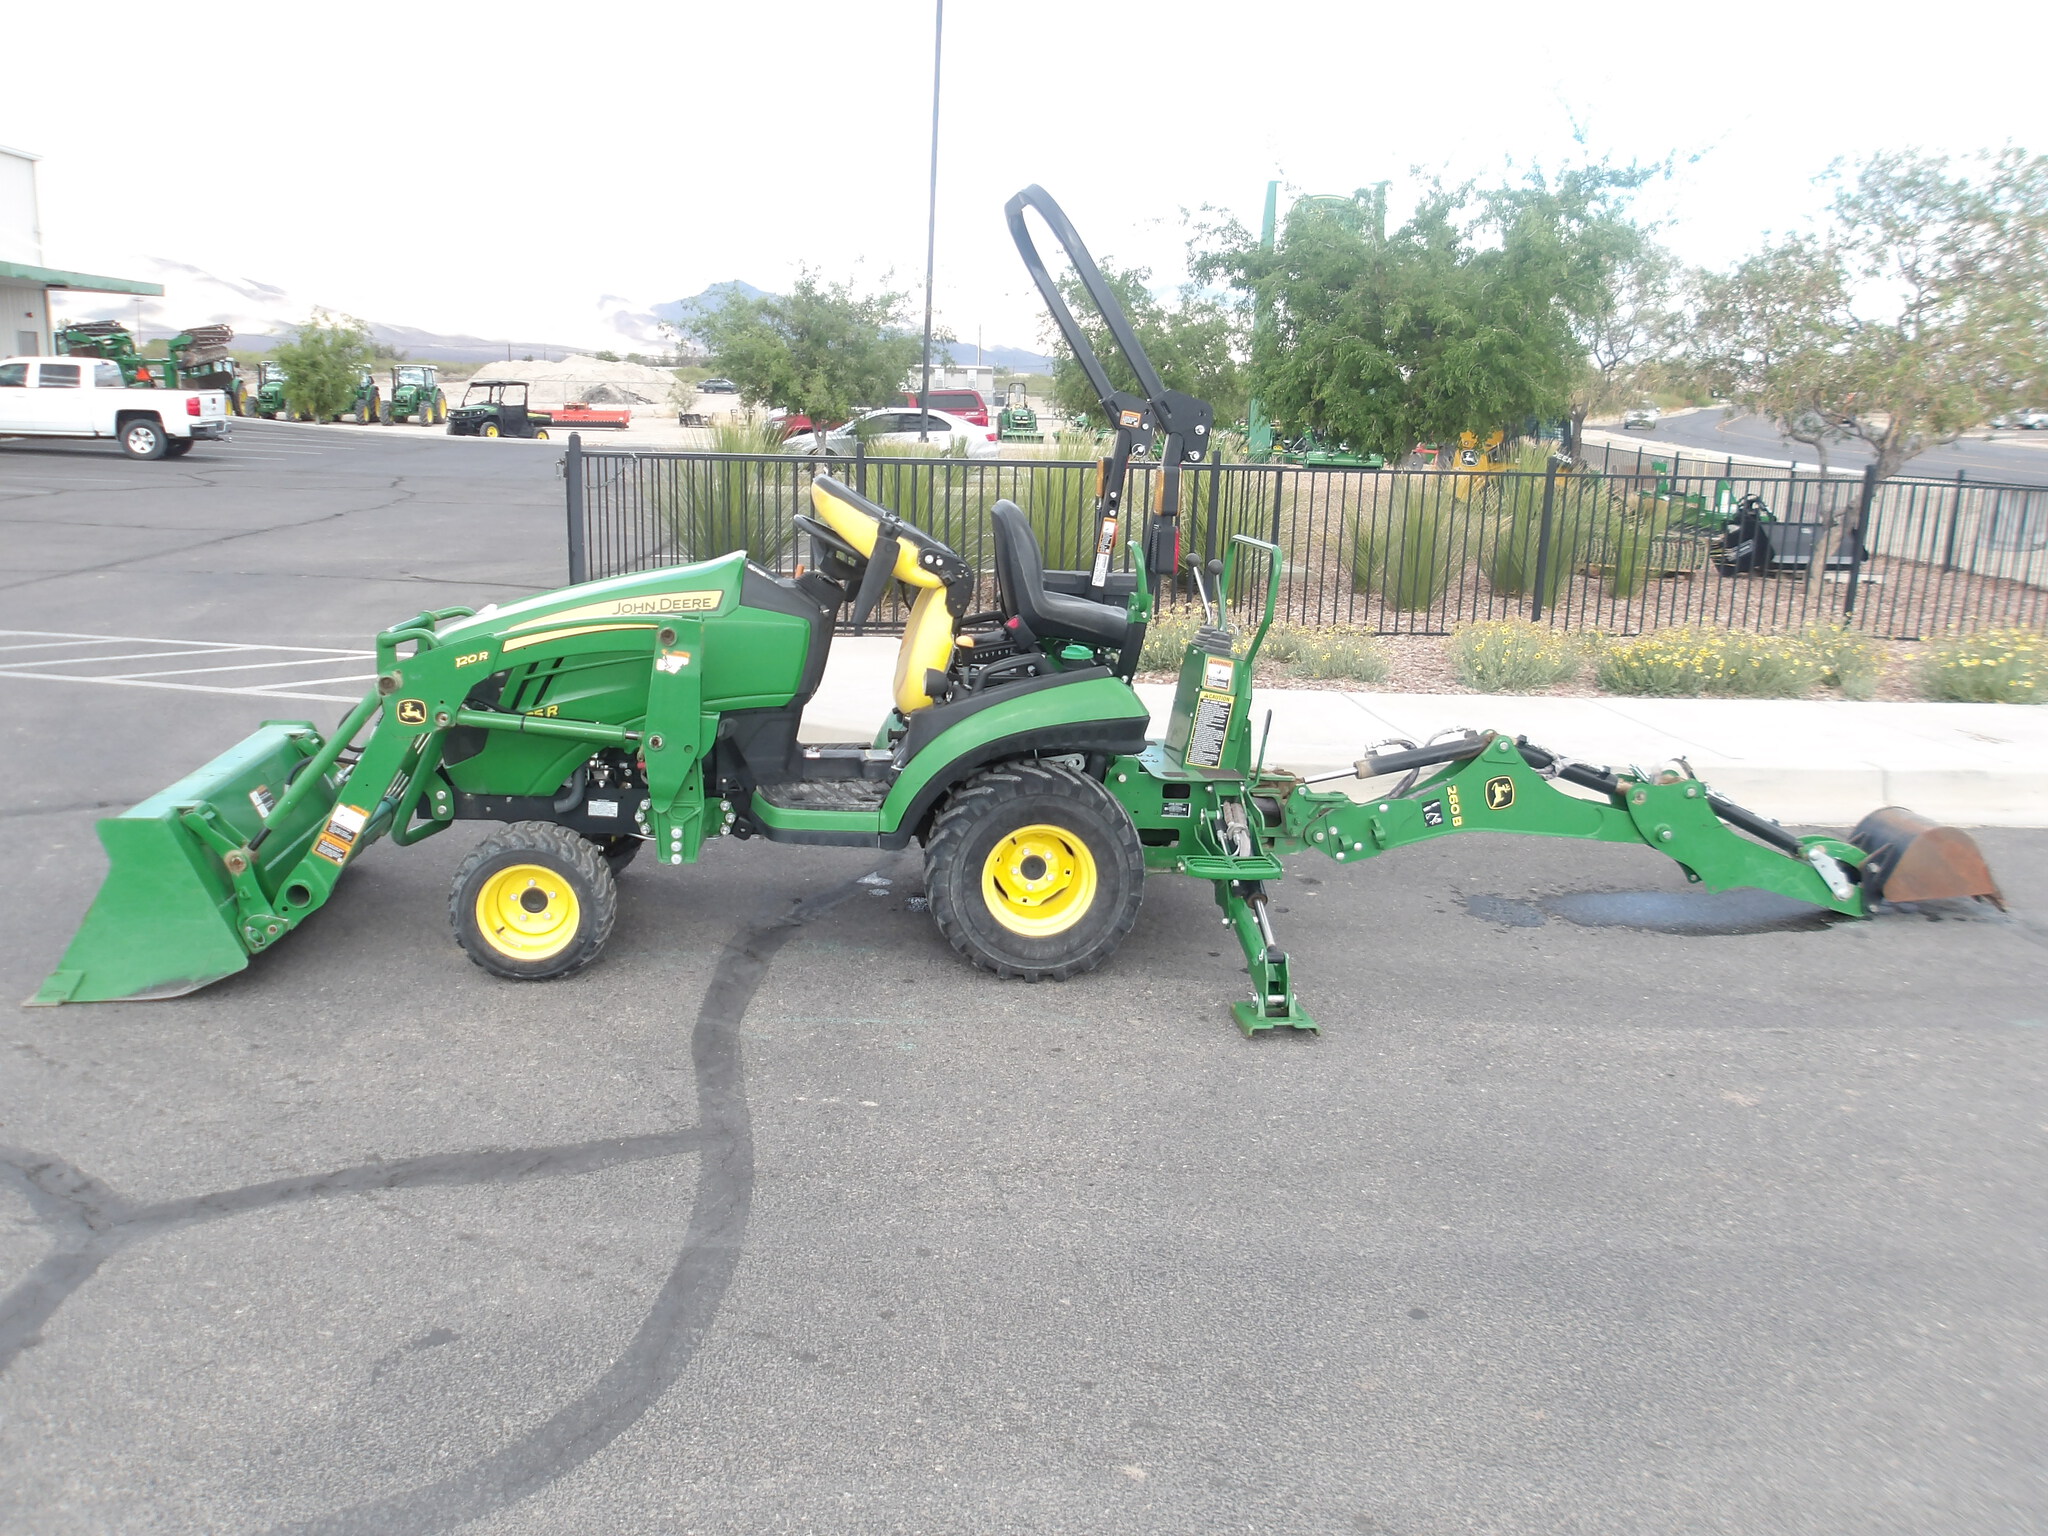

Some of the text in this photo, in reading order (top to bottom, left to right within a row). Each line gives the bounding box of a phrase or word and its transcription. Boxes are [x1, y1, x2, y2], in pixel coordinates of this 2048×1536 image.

[612, 598, 712, 615] JOHN DEERE
[1209, 694, 1230, 702] CAUTION
